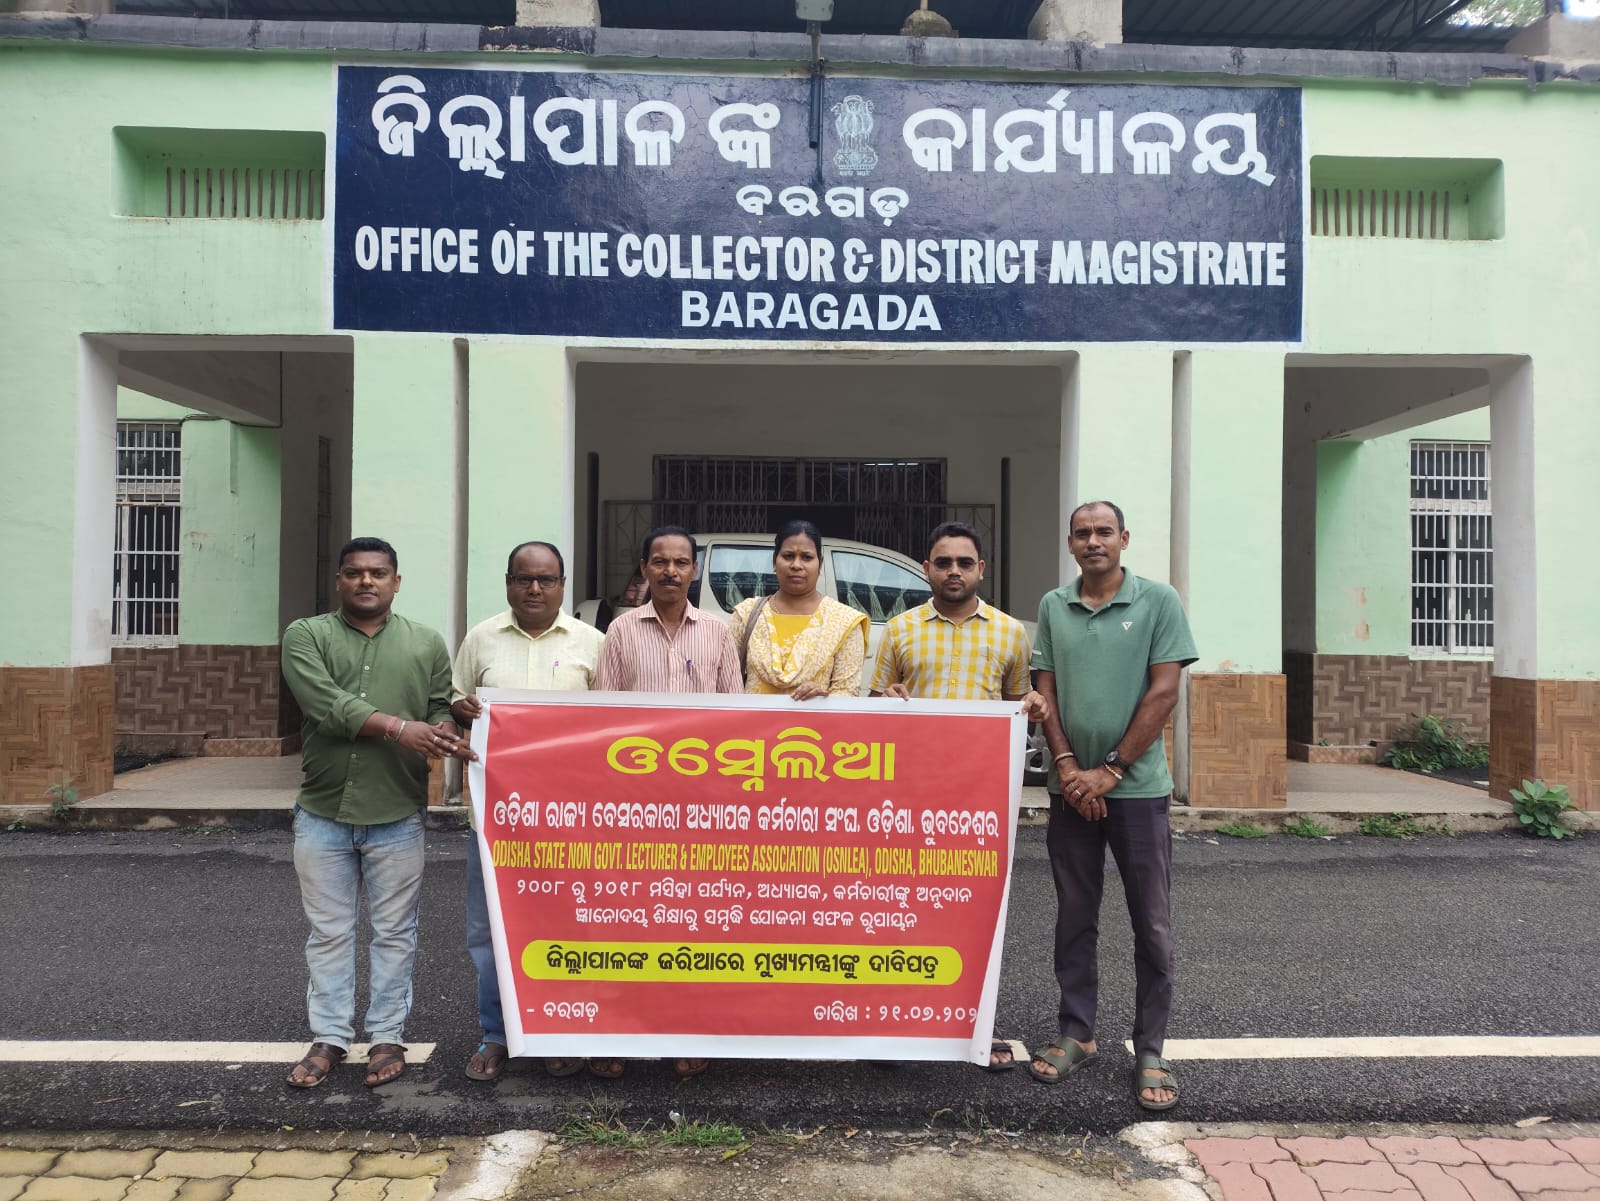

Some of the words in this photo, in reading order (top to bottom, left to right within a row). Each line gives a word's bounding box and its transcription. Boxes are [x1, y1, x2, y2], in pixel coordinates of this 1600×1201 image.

[902, 88, 1276, 186] କାର୍ଯ୍ୟାଳୟ
[736, 185, 909, 227] ବରଗଡ଼
[355, 225, 479, 274] OFFICE
[491, 229, 535, 275] OF
[543, 231, 609, 277] THE
[617, 233, 834, 282] COLLECTOR
[843, 237, 874, 283] &
[881, 238, 1039, 285] DISTRICT
[1048, 240, 1286, 286] MAGISTRATE
[681, 290, 942, 331] BARAGADA
[493, 791, 540, 832] ଓଡ଼ିଶା
[545, 801, 587, 829] ରାଜ୍ୟ
[592, 802, 681, 830] ବେସରକାରୀ
[685, 803, 751, 831] ଅଧ୍ୟାପକ
[757, 796, 820, 834] କର୍ମଚାରୀ
[492, 839, 531, 868] ODISHA
[533, 841, 567, 869] STATE
[567, 841, 592, 870] NON
[594, 842, 623, 871] GOVT.
[625, 842, 678, 871] LECTURER
[680, 843, 688, 871] &
[690, 843, 750, 872] EMPLOYEES
[751, 844, 821, 873] ASSOCIATION
[823, 846, 872, 880] (OSNLEA),
[875, 847, 916, 878] ODISHA,
[919, 849, 998, 877] BHUBANESWAR
[516, 879, 566, 896] ୨୦୦୮
[571, 881, 587, 904] ରୁ
[594, 881, 643, 897] ୨୦୧୮
[649, 876, 692, 899] ମସିହା
[916, 886, 973, 909] ଅନୁଦାନ
[575, 907, 649, 928] ଜ୍ଞାନୋଦୟ
[653, 903, 699, 931] ଶିକ୍ଷାରୁ
[749, 908, 806, 926] ଯୋଜନା
[812, 910, 854, 927] ସଫଳ
[546, 944, 649, 975] ଜିଲ୍ଲାପାଳଙ୍କ
[657, 946, 745, 972] ଜରିଆରେ
[868, 949, 939, 979] ଦାବିପତ୍ର
[543, 1001, 599, 1023] ବରଗଡ଼
[813, 1000, 859, 1023] ତାରିଖ
